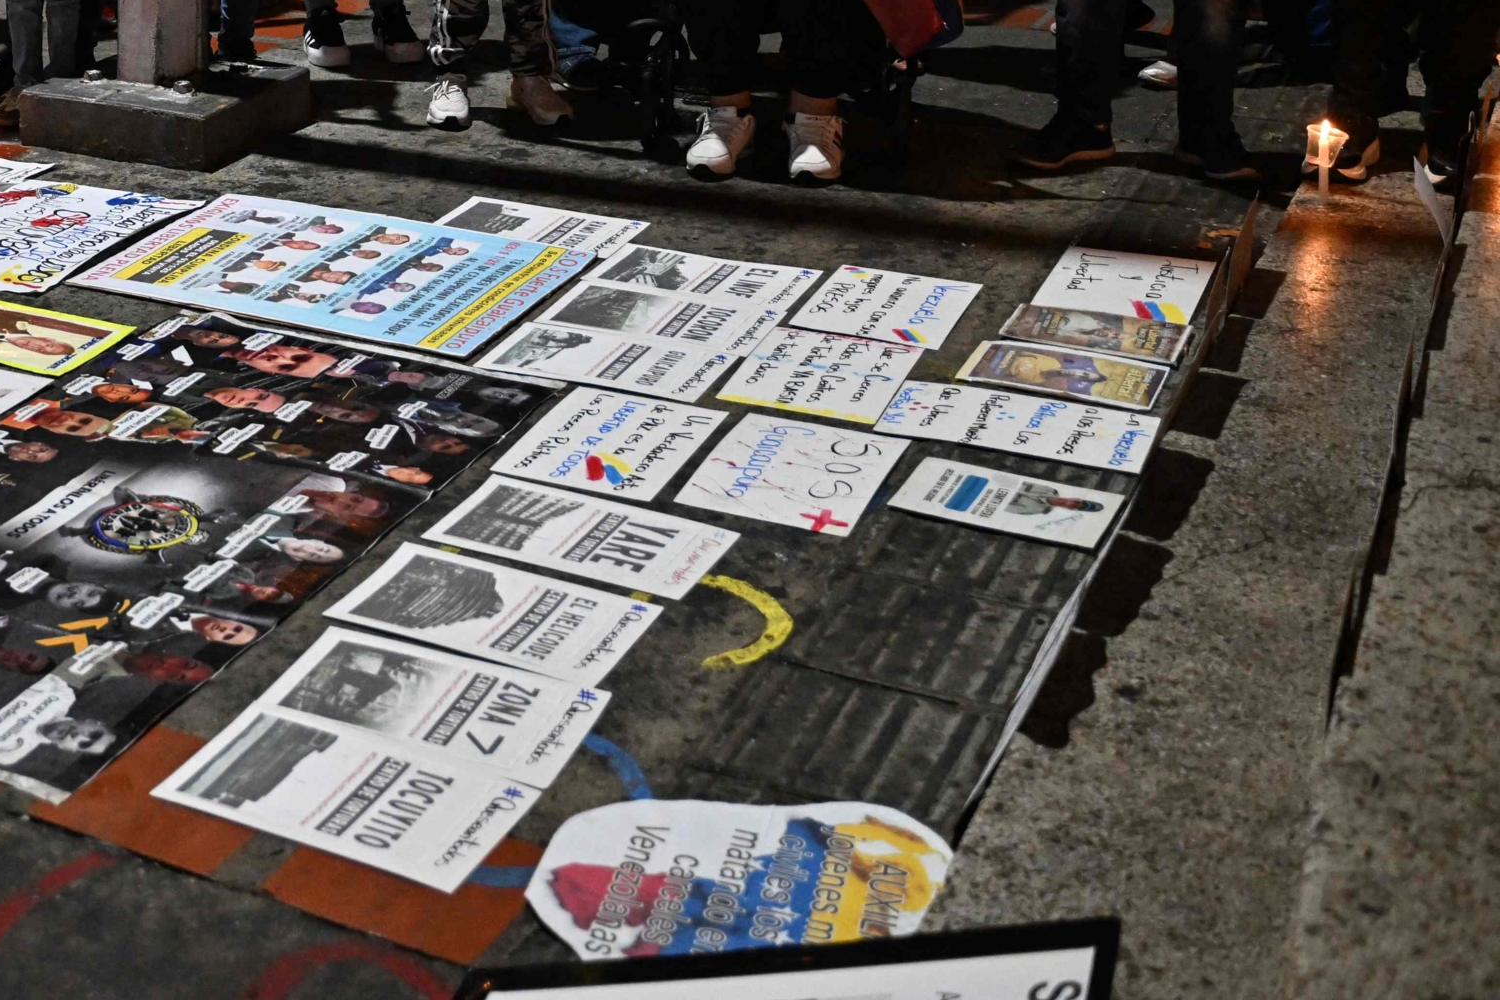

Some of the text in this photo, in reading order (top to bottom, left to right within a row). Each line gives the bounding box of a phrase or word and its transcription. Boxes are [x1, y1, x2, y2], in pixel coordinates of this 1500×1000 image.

[81, 199, 238, 281] EXIGIMOS LIBERTAD PLENA
[139, 241, 188, 263] LIBERTAD
[542, 250, 559, 258] Se
[156, 258, 206, 283] CUMPLIDA
[744, 267, 778, 277] EL
[901, 276, 921, 285] No
[1066, 252, 1120, 290] Libertad
[1116, 273, 1144, 281] y
[1145, 258, 1203, 298] Justicia
[443, 273, 561, 348] Fuerte Guaicaipuro
[463, 289, 507, 315] condiciones
[815, 282, 853, 312] PRESOS
[908, 285, 958, 324] Venezuela
[380, 318, 414, 335] VERDE
[425, 317, 468, 342] inhumanas
[680, 307, 737, 341] TOCORON
[855, 323, 875, 336] sus
[867, 311, 886, 322] con
[634, 350, 686, 385] GUAICAIPURO
[772, 334, 844, 404] de YA BASTA
[805, 341, 870, 402] Todos los Centros
[879, 346, 912, 359] Que
[588, 393, 614, 405] Los
[548, 400, 646, 476] LIBERTAD DE TODOS
[612, 403, 676, 455] de PAZ es la
[680, 415, 713, 427] Un
[634, 431, 694, 472] Verdadero
[3, 513, 51, 539] TODOS
[562, 512, 625, 562] CENTRO DE TORTURAS
[588, 521, 680, 573] YARE
[489, 588, 567, 652] CENTRO DE TORTURAS
[520, 597, 598, 660] EL HELICOIDE
[423, 673, 498, 746] CENTRO DE TORTURAS
[465, 681, 540, 755] ZONA 7
[314, 757, 410, 837] CENTRO DE TORTURAS
[353, 770, 454, 848] TOCUYITO
[584, 824, 672, 957] Venezolanas
[705, 827, 760, 924] matando
[641, 854, 699, 946] carceles
[749, 906, 781, 941] los
